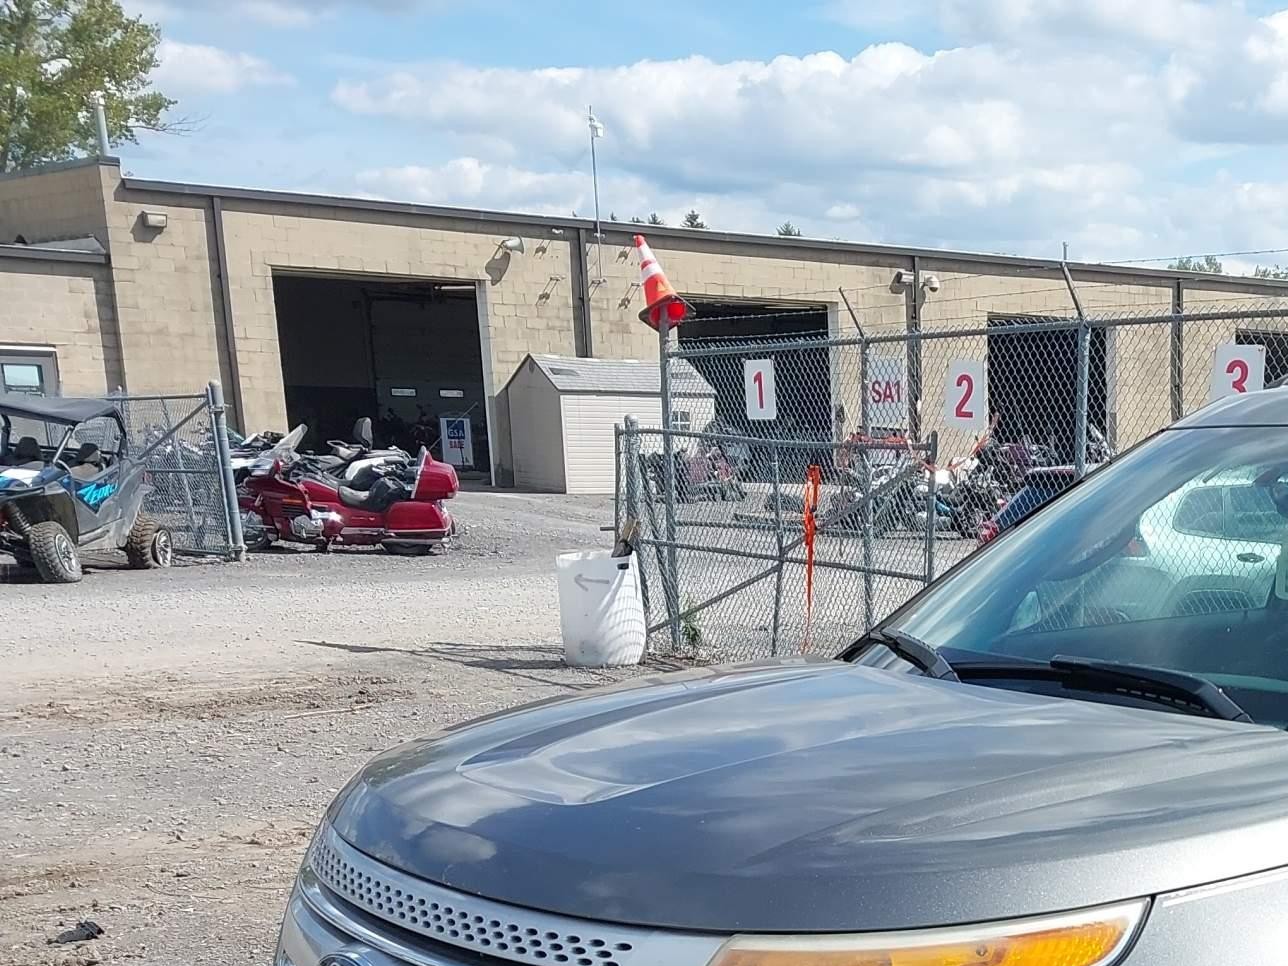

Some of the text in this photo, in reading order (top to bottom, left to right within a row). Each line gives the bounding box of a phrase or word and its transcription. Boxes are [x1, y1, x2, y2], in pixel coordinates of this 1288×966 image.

[753, 370, 765, 409] 1
[955, 373, 974, 418] 2
[1226, 359, 1249, 394] 3
